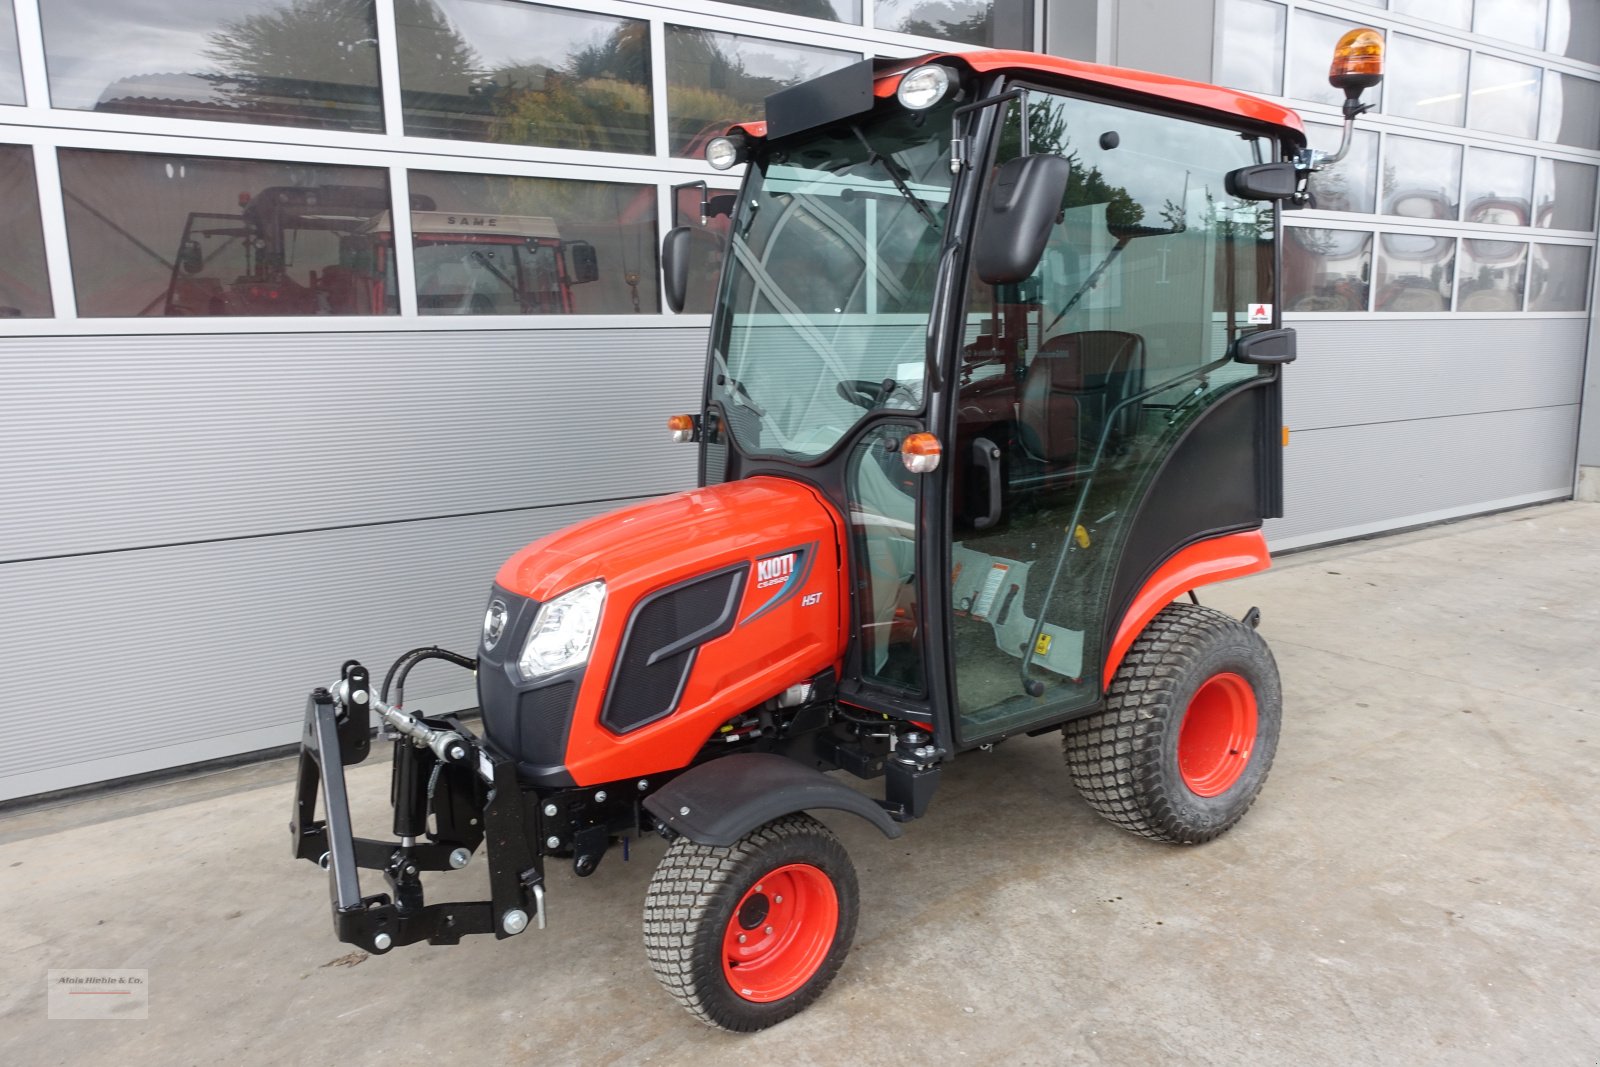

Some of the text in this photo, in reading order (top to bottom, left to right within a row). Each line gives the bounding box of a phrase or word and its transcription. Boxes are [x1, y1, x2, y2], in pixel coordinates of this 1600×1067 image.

[447, 216, 497, 227] SAME
[757, 553, 794, 582] KIOTI
[801, 592, 823, 607] HST
